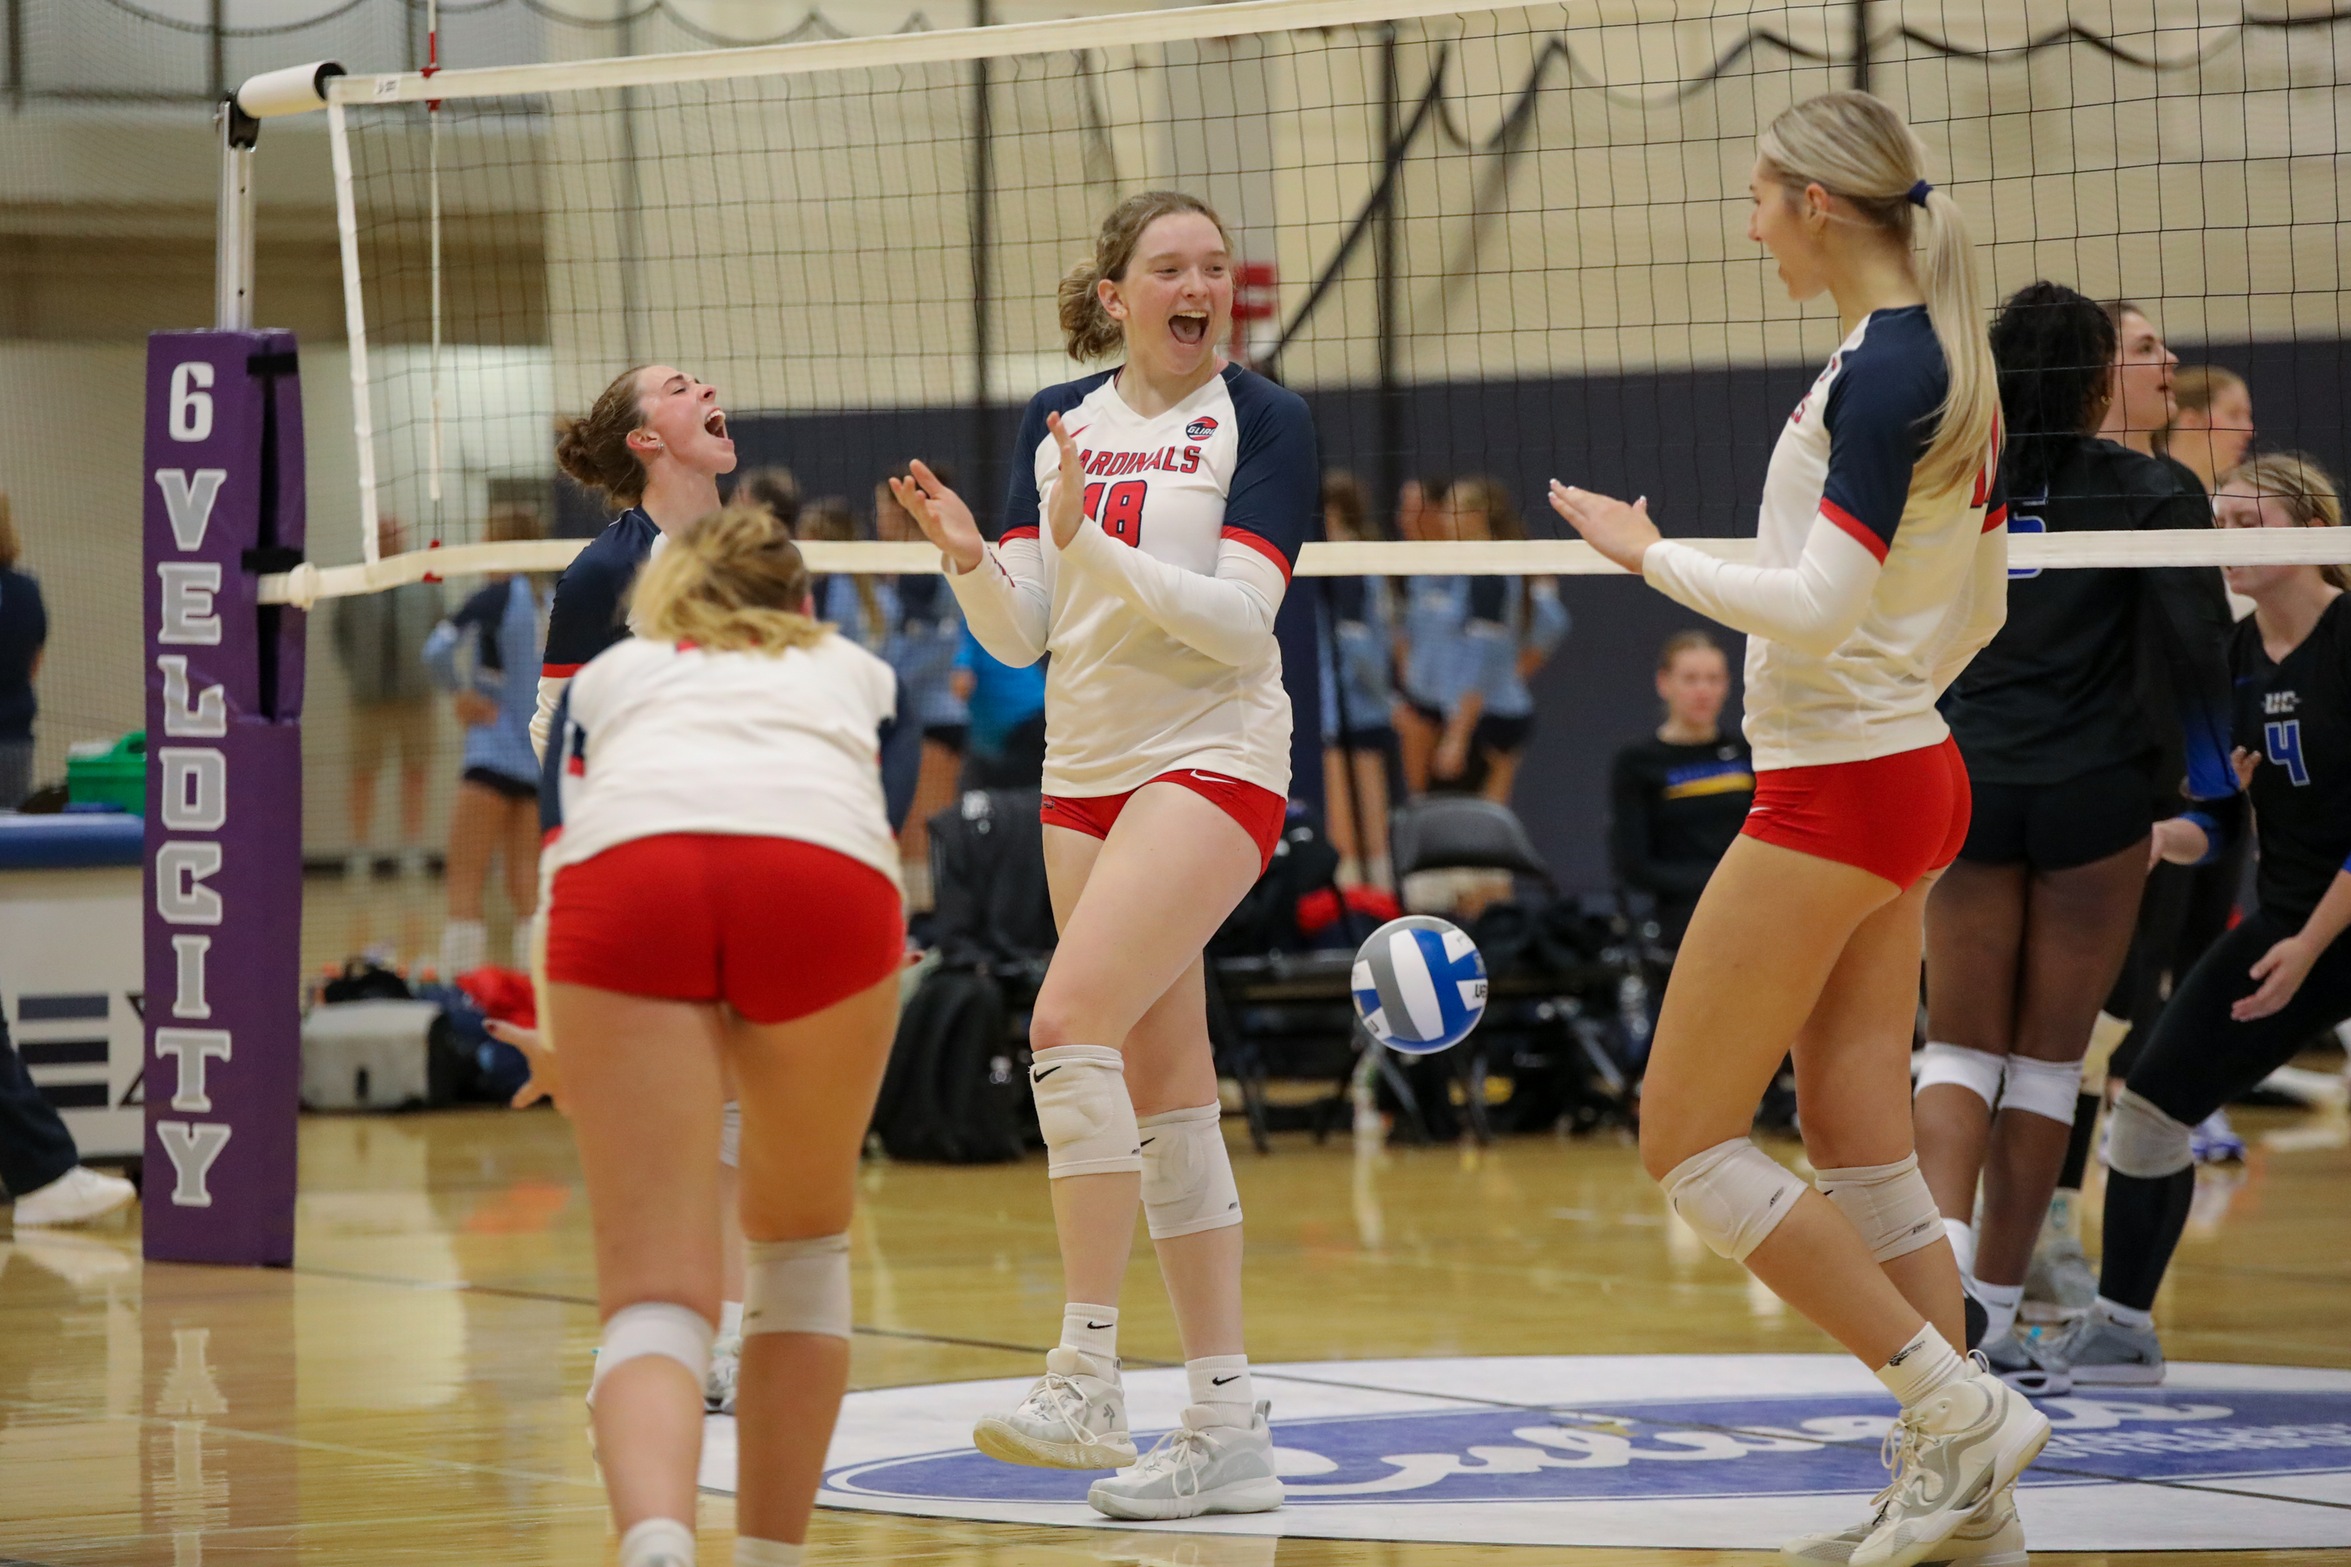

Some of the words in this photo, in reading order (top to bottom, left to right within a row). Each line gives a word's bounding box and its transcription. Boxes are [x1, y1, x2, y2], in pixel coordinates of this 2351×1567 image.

[168, 361, 215, 443] 6
[1078, 445, 1202, 477] ARDINALS
[2264, 719, 2311, 788] 4
[154, 466, 232, 1208] VELOCITY
